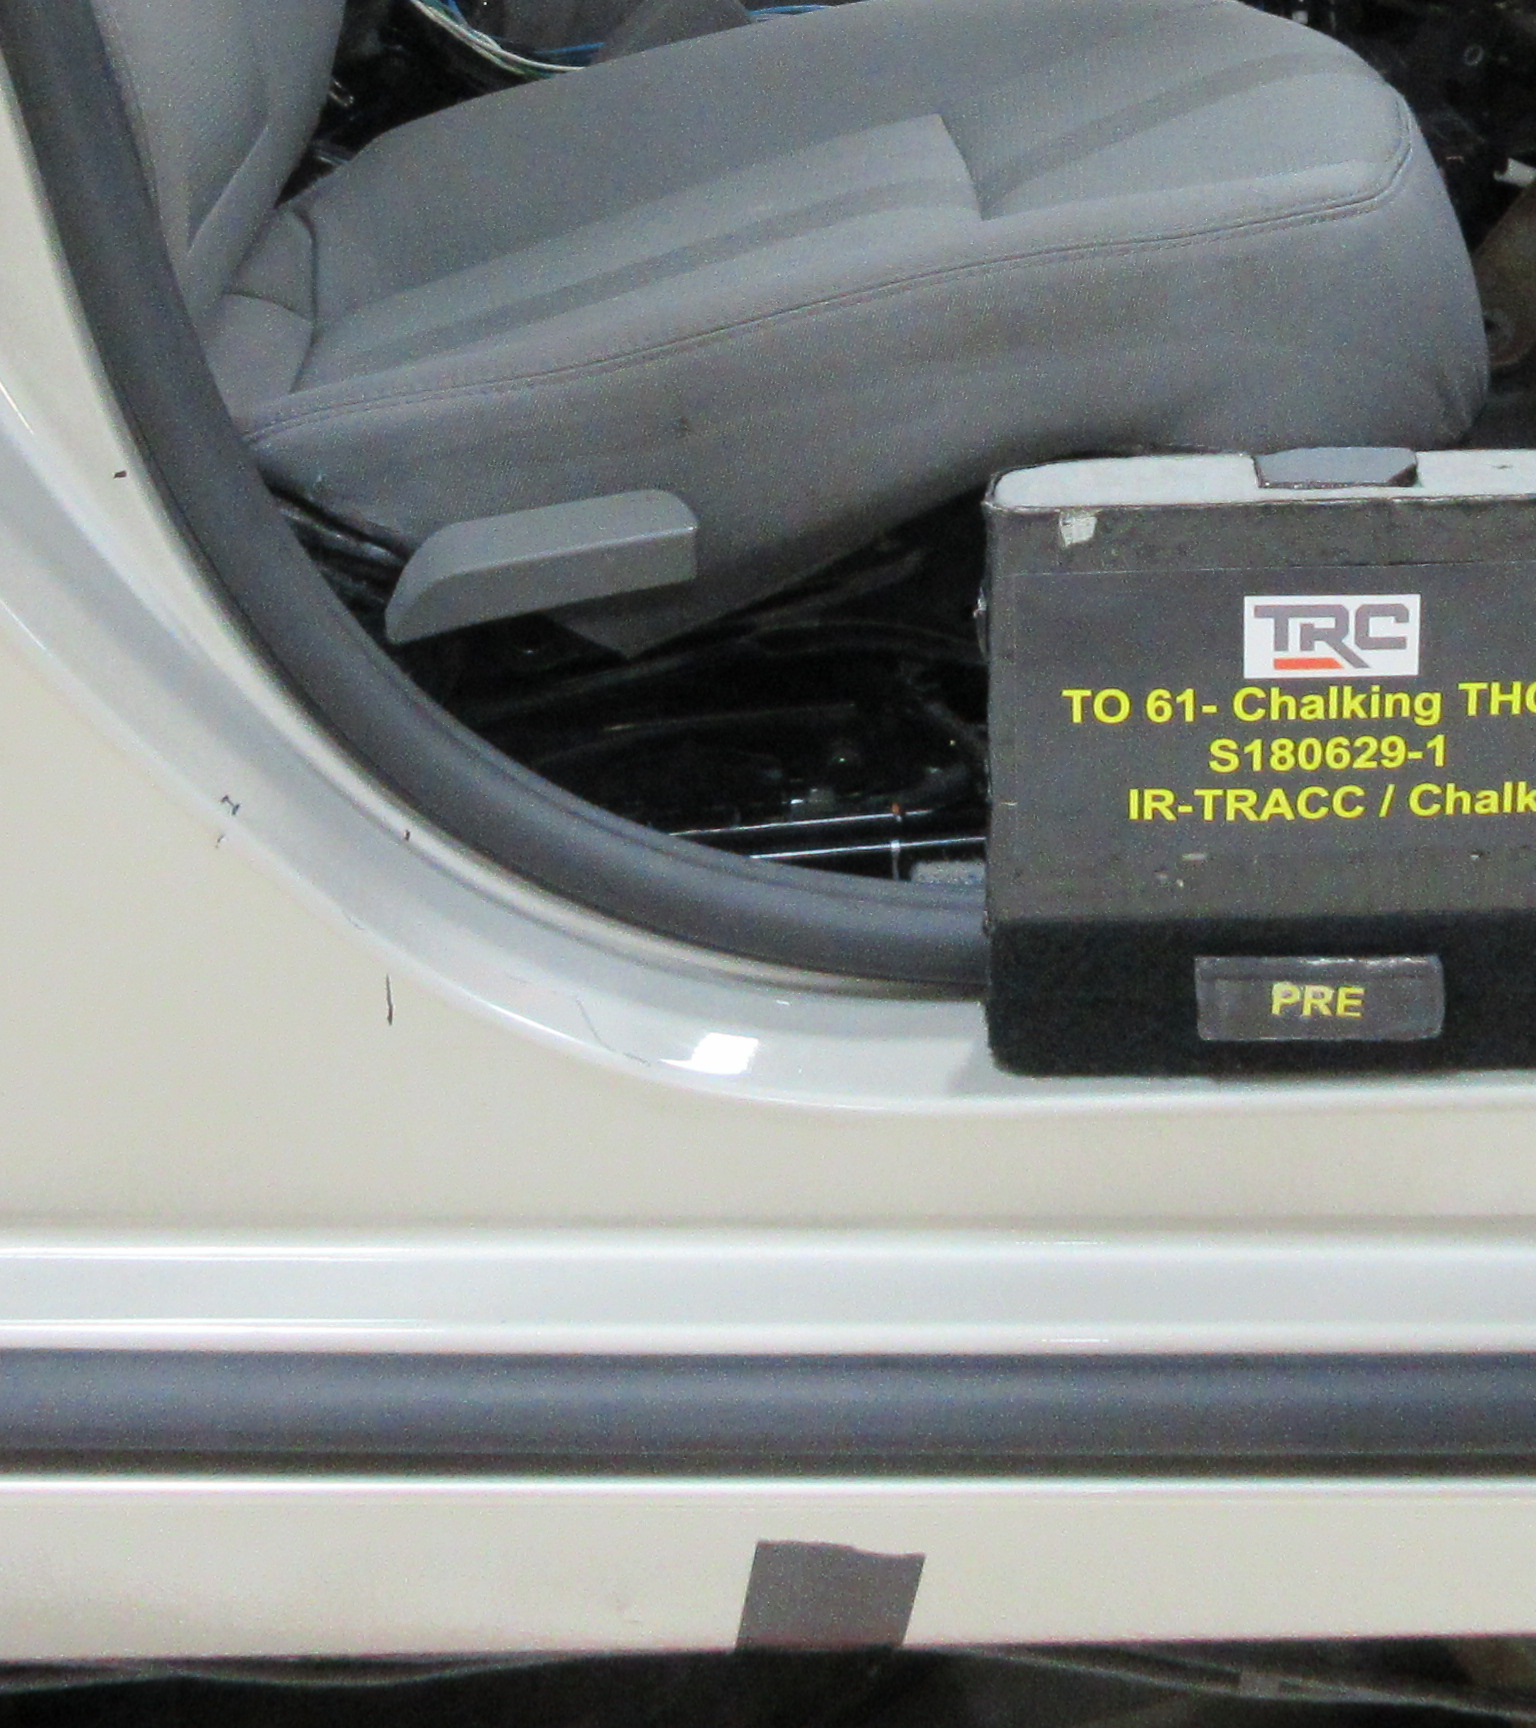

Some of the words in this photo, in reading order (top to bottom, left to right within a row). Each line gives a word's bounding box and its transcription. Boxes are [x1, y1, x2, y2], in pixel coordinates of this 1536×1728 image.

[1253, 604, 1410, 669] TRC
[1062, 688, 1132, 725] TO
[1145, 688, 1219, 724] 61-
[1232, 685, 1443, 727] Chalking
[1208, 734, 1447, 774] S180629-1
[1128, 784, 1366, 822] IR-TRACC
[1378, 784, 1396, 819] /
[1271, 984, 1365, 1018] PRE
